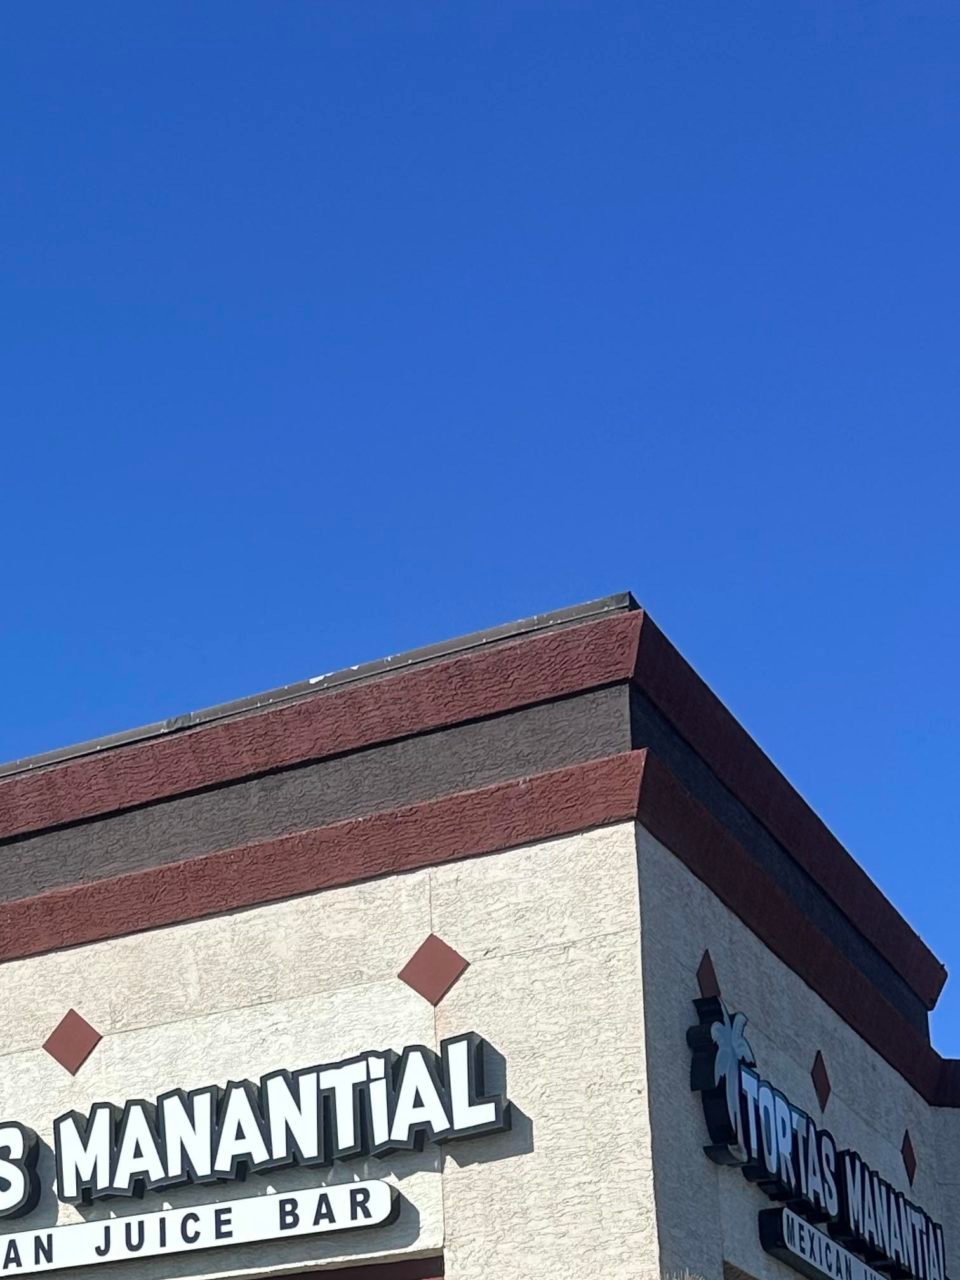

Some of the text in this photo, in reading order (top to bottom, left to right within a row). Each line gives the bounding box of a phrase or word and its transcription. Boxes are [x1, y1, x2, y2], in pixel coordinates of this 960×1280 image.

[741, 1070, 839, 1217] TORTAS
[94, 1206, 234, 1258] JUICE
[278, 1187, 374, 1229] BAR
